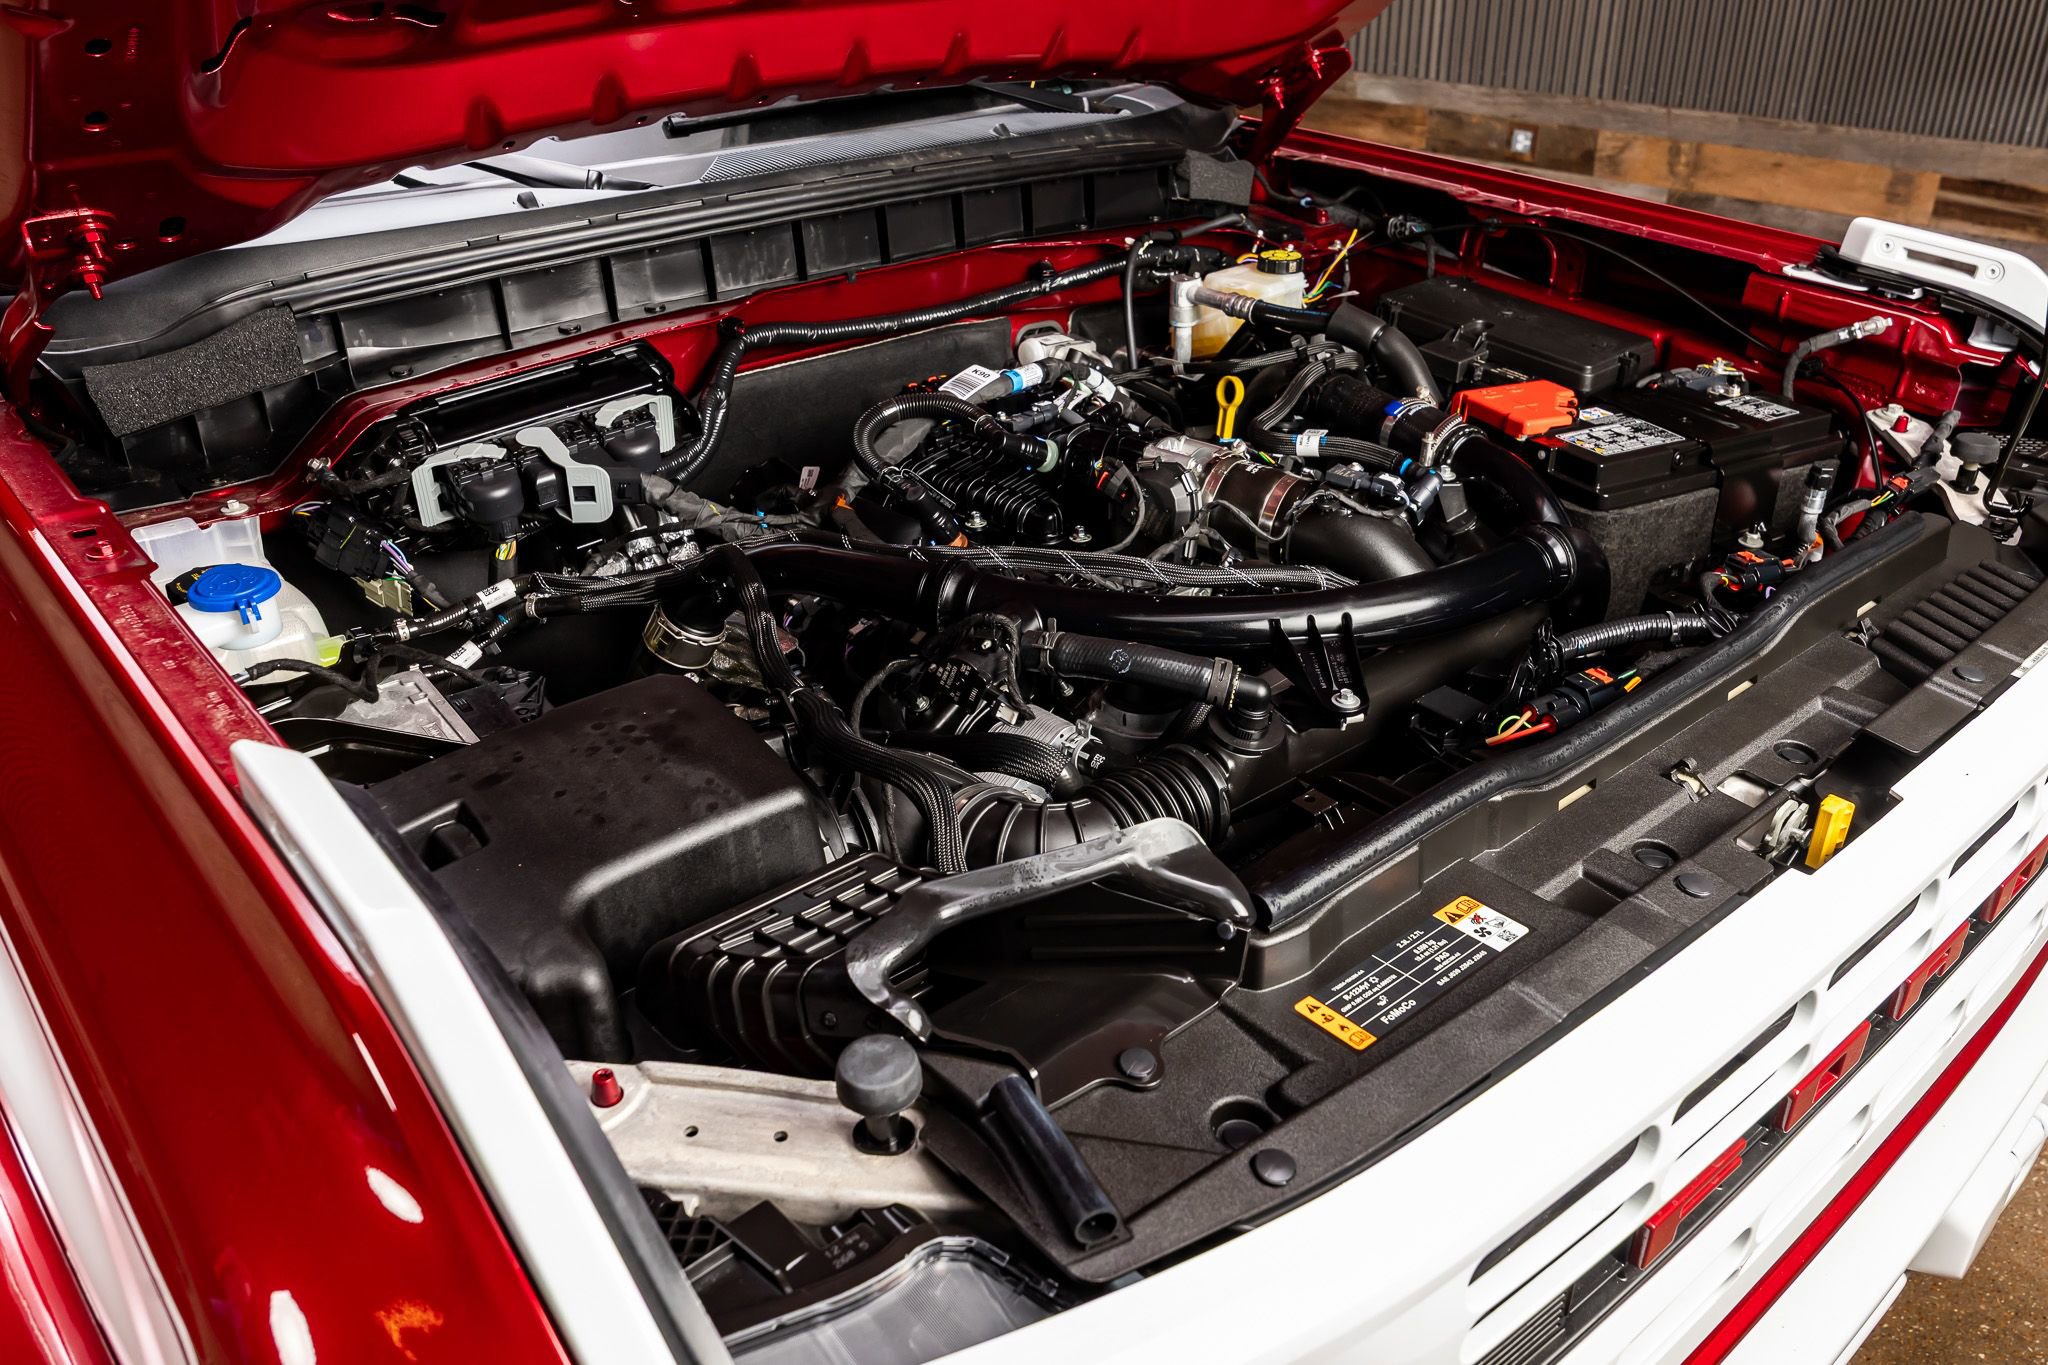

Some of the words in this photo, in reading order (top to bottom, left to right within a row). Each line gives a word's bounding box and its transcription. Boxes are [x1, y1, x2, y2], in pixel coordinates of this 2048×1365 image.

[971, 368, 991, 379] K90
[1434, 951, 1451, 962] PAG
[1436, 975, 1450, 986] SAE
[1379, 999, 1417, 1025] FoMoCo
